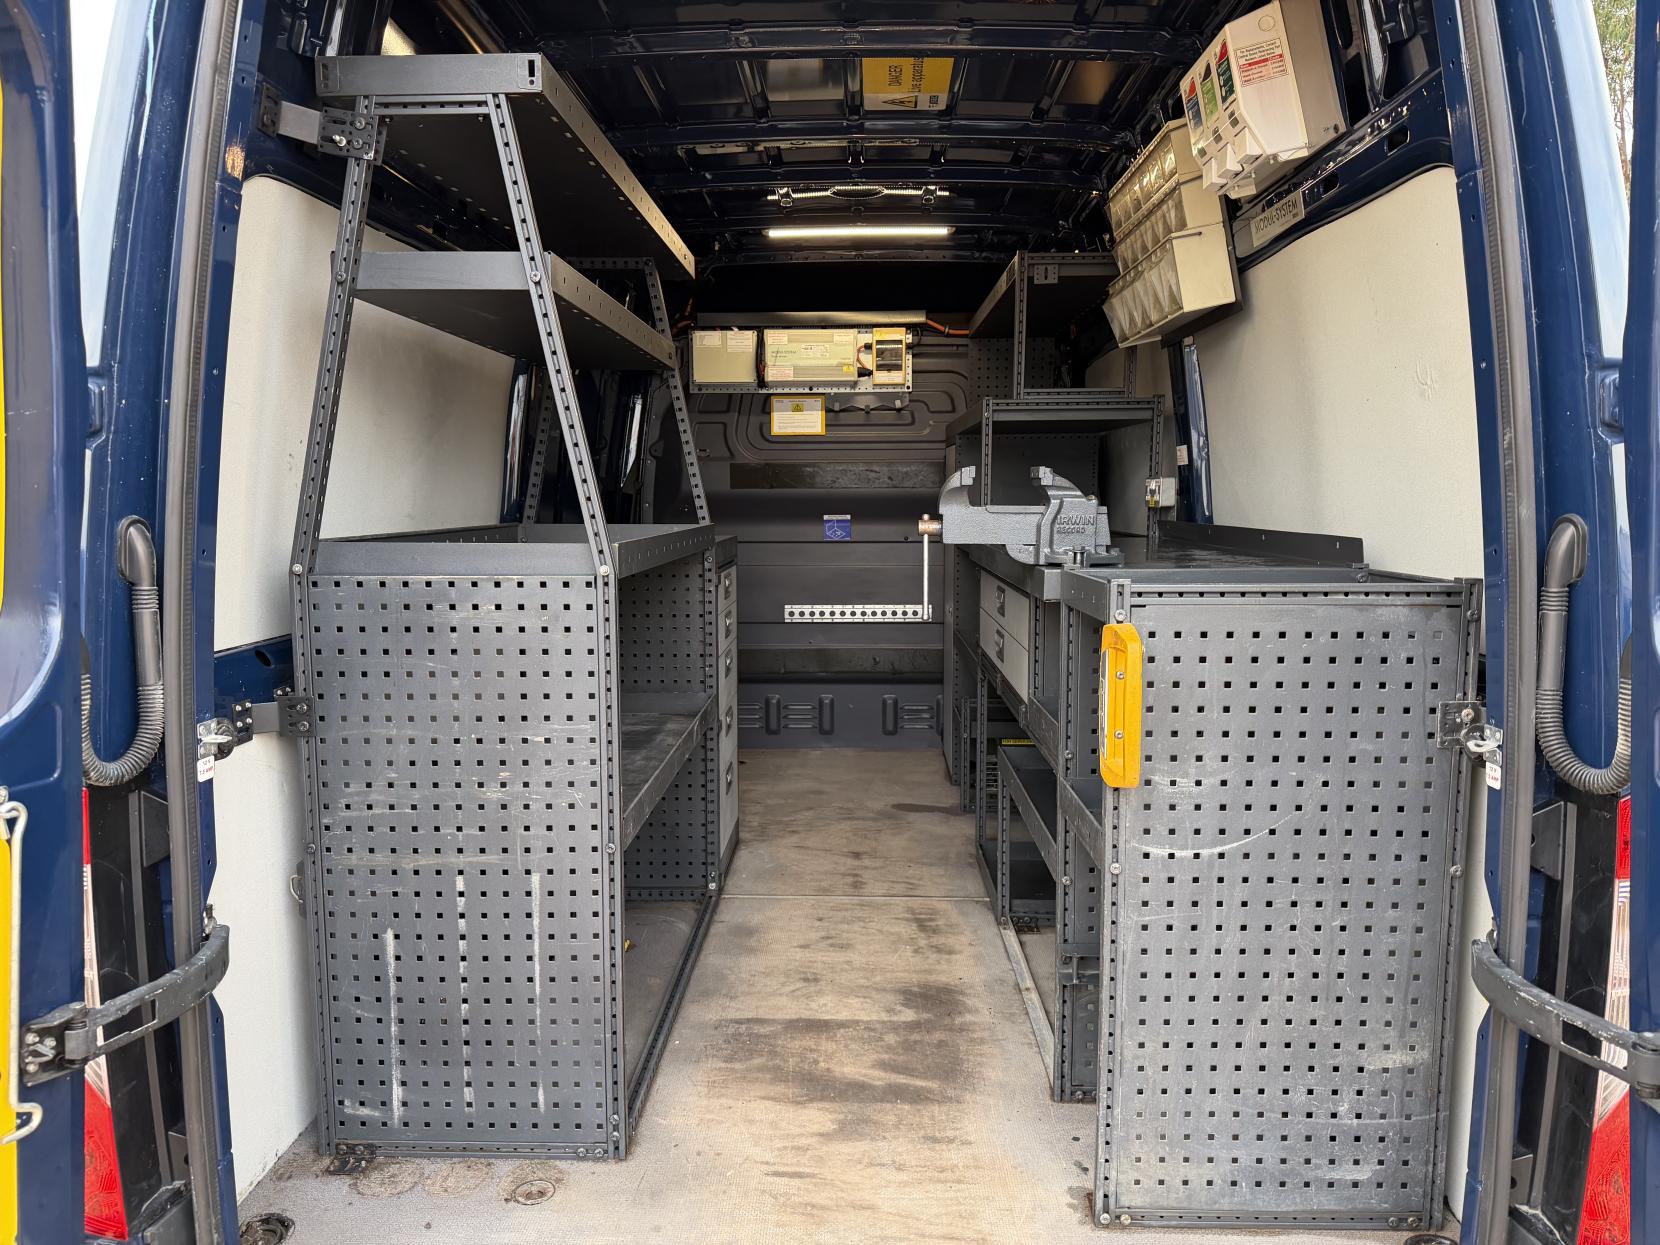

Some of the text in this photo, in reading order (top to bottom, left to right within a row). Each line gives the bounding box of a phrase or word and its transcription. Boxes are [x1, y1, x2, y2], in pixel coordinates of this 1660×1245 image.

[888, 64, 903, 87] DANGER
[1254, 197, 1298, 234] MODUL-SYSTEM
[1056, 514, 1095, 526] IRWIN
[1056, 526, 1086, 534] RECORD
